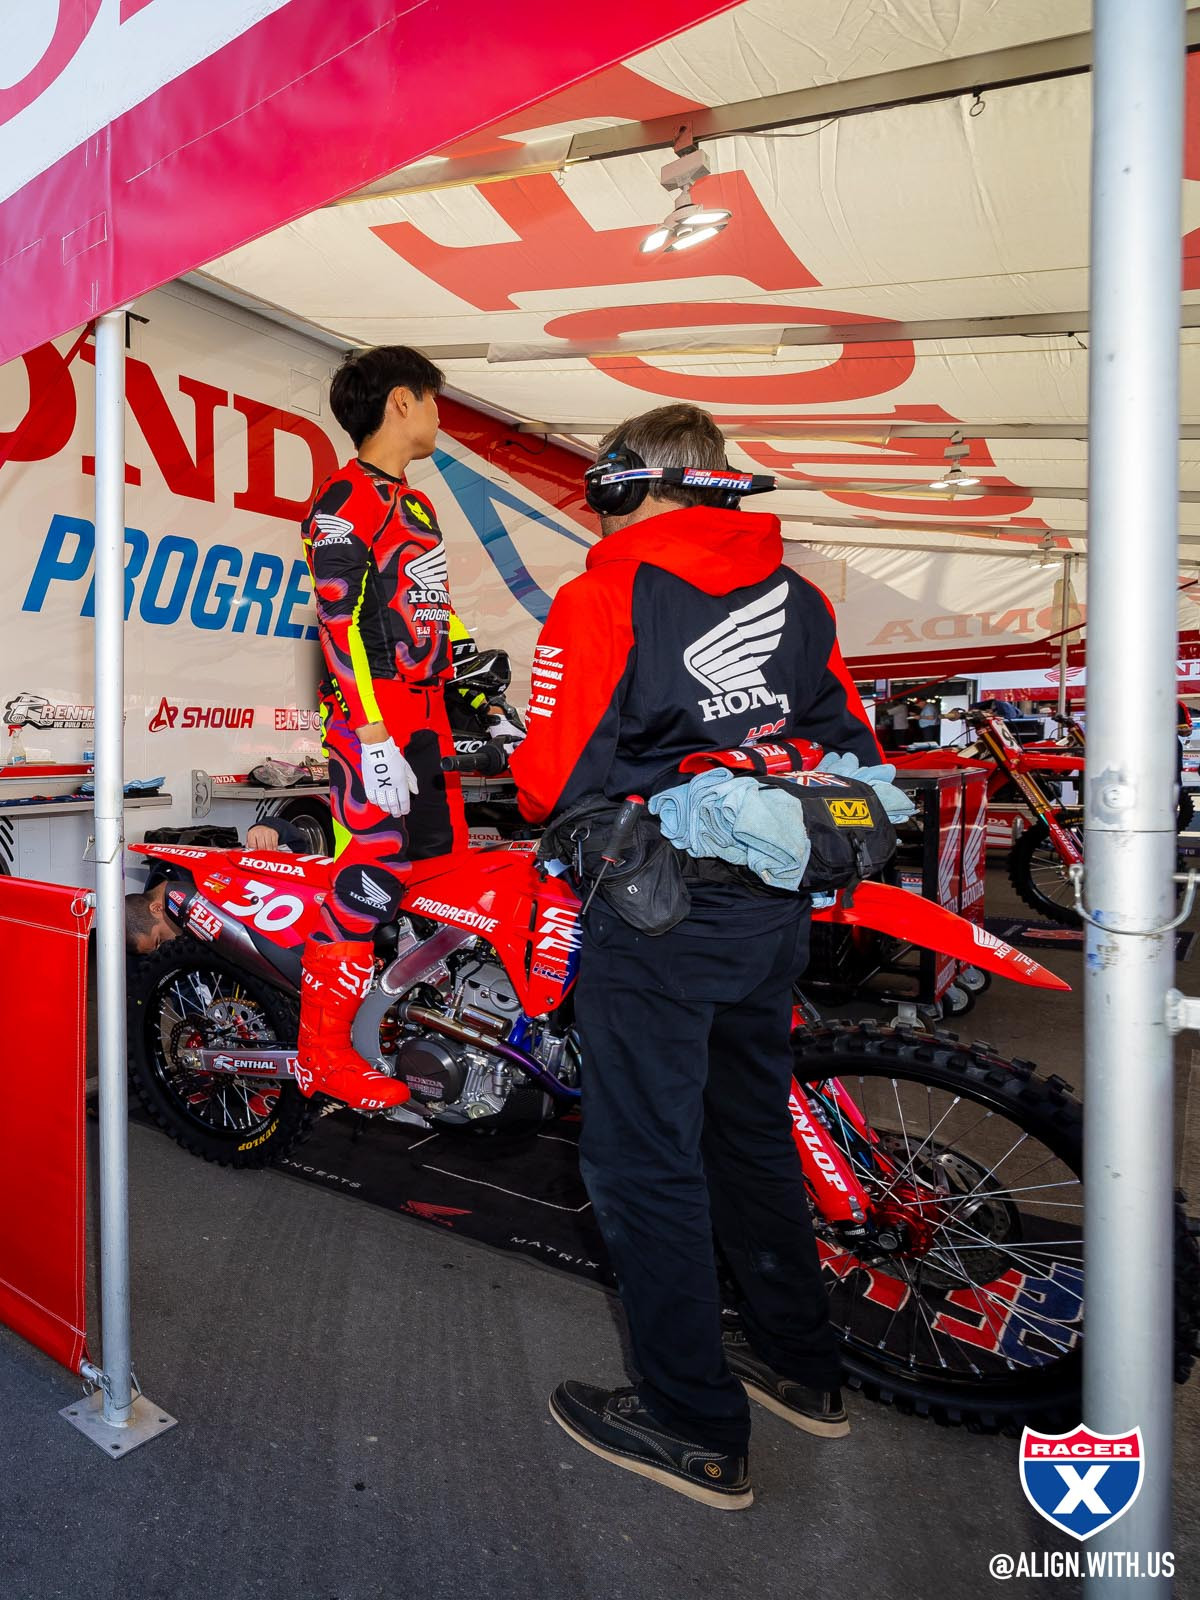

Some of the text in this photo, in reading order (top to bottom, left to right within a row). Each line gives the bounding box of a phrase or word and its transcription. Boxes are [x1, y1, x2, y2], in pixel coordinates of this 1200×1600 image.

[682, 476, 751, 490] GRIFFITH
[695, 470, 711, 478] BEN
[312, 536, 353, 549] HONDA
[22, 514, 321, 640] PROGRE
[408, 590, 450, 604] HON
[412, 608, 450, 622] PROGR
[40, 704, 95, 720] RENT
[698, 686, 791, 722] HONA
[180, 706, 255, 729] SHOWA
[211, 775, 237, 785] ONDA
[370, 749, 394, 789] FOX
[152, 845, 208, 859] DUNLOP
[238, 856, 306, 877] HONDA
[222, 879, 304, 932] 30
[349, 890, 388, 912] HONDA
[411, 895, 498, 933] PROGRESSIVE
[536, 906, 584, 953] CRF
[301, 967, 324, 991] FOX
[360, 1097, 386, 1109] FOX
[237, 1121, 278, 1151] DUNLOP
[509, 1236, 600, 1270] MATRIX
